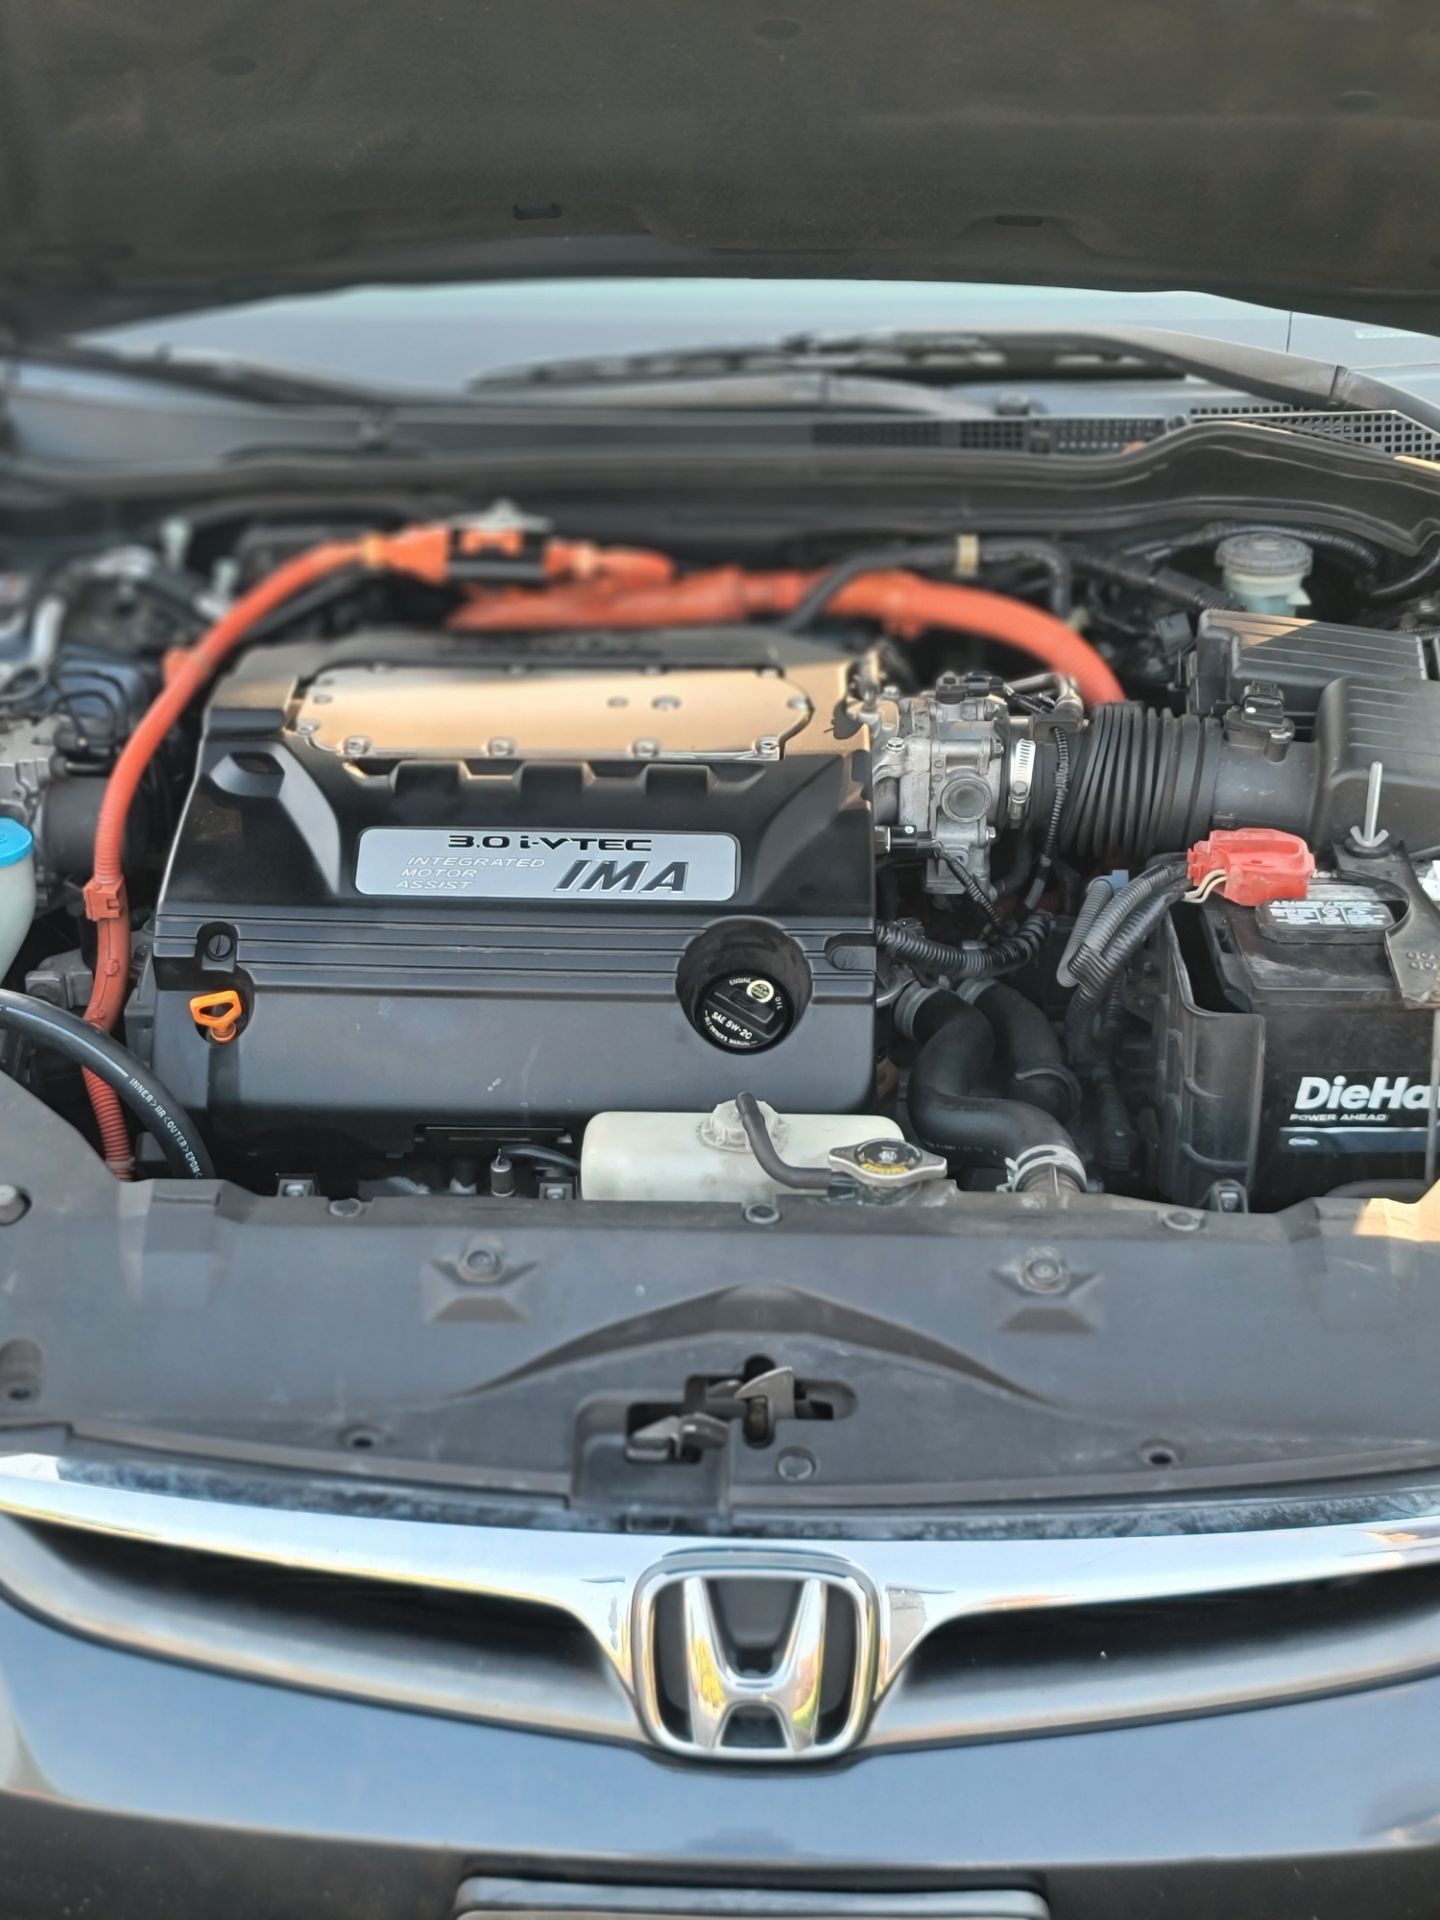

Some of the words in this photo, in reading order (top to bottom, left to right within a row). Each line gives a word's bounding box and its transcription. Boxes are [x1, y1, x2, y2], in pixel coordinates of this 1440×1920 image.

[448, 835, 510, 849] 3.0
[520, 835, 652, 852] i-VTEC
[407, 856, 545, 868] INTEGRATED
[400, 868, 478, 878] MOTOR
[553, 859, 689, 895] IMA
[394, 879, 473, 890] ASSIST
[775, 996, 783, 1010] OIL
[711, 1011, 727, 1024] SAE
[1294, 1075, 1440, 1110] DieHa
[1288, 1113, 1337, 1122] POWER
[1339, 1113, 1389, 1122] AHEAD
